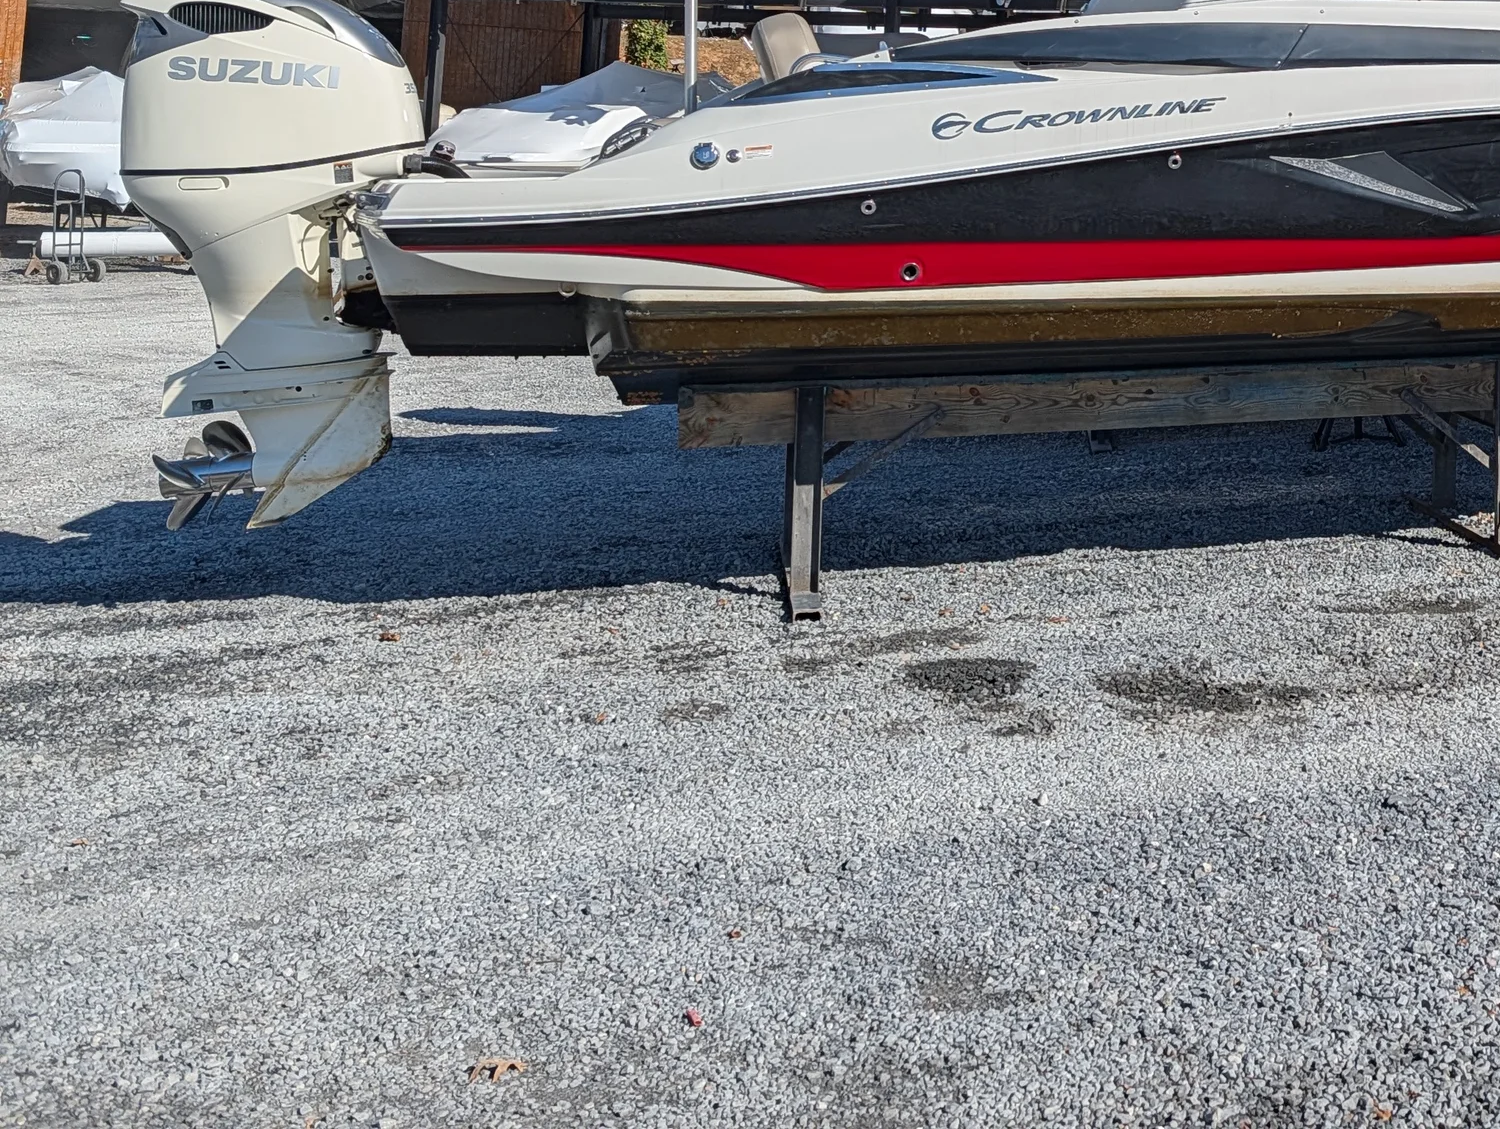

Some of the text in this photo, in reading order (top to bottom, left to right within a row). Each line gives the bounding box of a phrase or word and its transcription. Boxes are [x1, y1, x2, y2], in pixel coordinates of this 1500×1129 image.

[167, 56, 341, 89] SUZUKI
[403, 82, 418, 94] 35
[973, 96, 1227, 134] CROWNLINE
